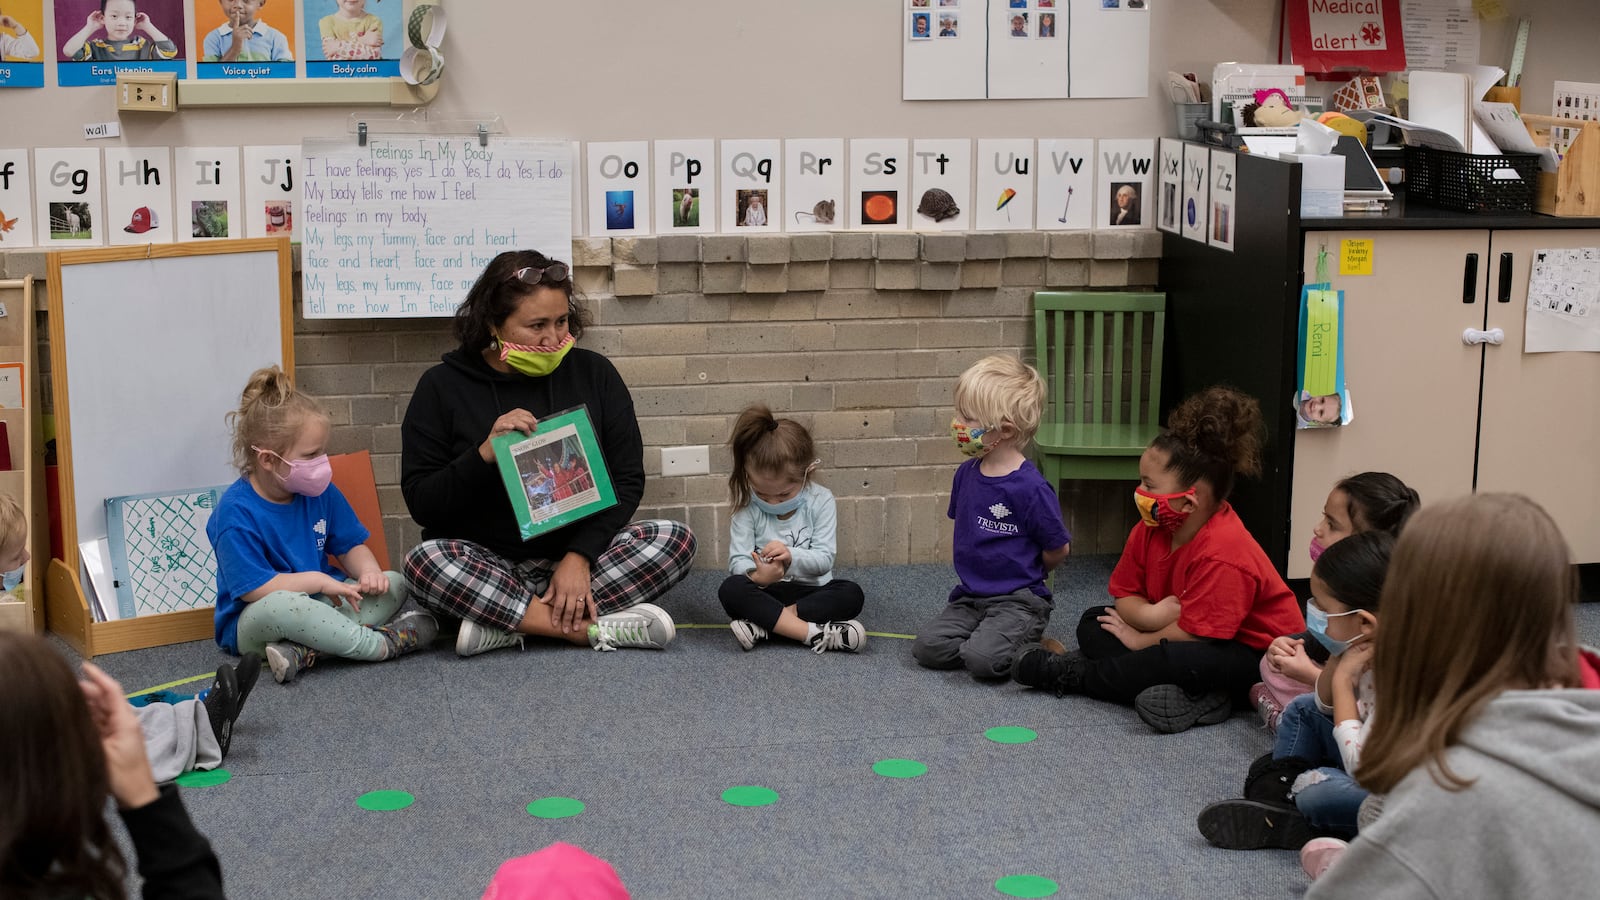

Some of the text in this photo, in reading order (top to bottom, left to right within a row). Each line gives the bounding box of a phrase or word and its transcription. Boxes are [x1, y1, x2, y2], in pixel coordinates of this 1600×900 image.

[1312, 0, 1379, 15] Medical
[1314, 32, 1357, 49] alert
[92, 65, 112, 75] Ears
[222, 66, 270, 78] Voice quiet
[333, 64, 378, 76] Body calm
[85, 124, 107, 136] wall
[370, 140, 493, 165] Feelings In My Body
[799, 151, 832, 176] Rr
[863, 152, 897, 175] Ss
[915, 151, 949, 175] Tt
[994, 151, 1029, 175] Uu
[1051, 151, 1084, 175] Vv
[1103, 151, 1151, 175] Ww
[1163, 152, 1179, 177] Xx
[0, 161, 15, 190] f
[50, 160, 89, 195] Gg
[118, 159, 160, 186] Hh
[195, 160, 221, 186] Ii
[260, 158, 293, 192] Jj
[305, 157, 316, 176] I
[325, 158, 351, 177] have
[428, 158, 438, 177] I
[484, 159, 492, 178] I
[536, 159, 545, 178] I
[599, 154, 639, 180] Oo
[670, 152, 702, 185] Pp
[731, 151, 772, 183] Qq
[1189, 157, 1203, 192] Yy
[1216, 164, 1232, 192] Zz
[305, 181, 324, 204] My
[330, 181, 356, 205] body
[361, 181, 383, 200] tells
[391, 189, 407, 200] me
[412, 182, 436, 200] how
[441, 181, 448, 200] I
[305, 204, 347, 228] feelings
[356, 208, 367, 222] in
[375, 211, 393, 228] my
[305, 227, 324, 250] My
[357, 235, 374, 250] my
[424, 227, 446, 245] face
[454, 228, 475, 245] and
[307, 249, 329, 268] face
[338, 250, 360, 268] and
[415, 249, 436, 268] face
[443, 251, 463, 268] and
[305, 273, 325, 297] My
[363, 281, 378, 295] my
[431, 272, 453, 290] face
[307, 296, 326, 314] tell
[337, 303, 355, 313] me
[365, 296, 390, 313] how
[1311, 322, 1331, 357] Remi
[977, 516, 1019, 533] TREVISTA
